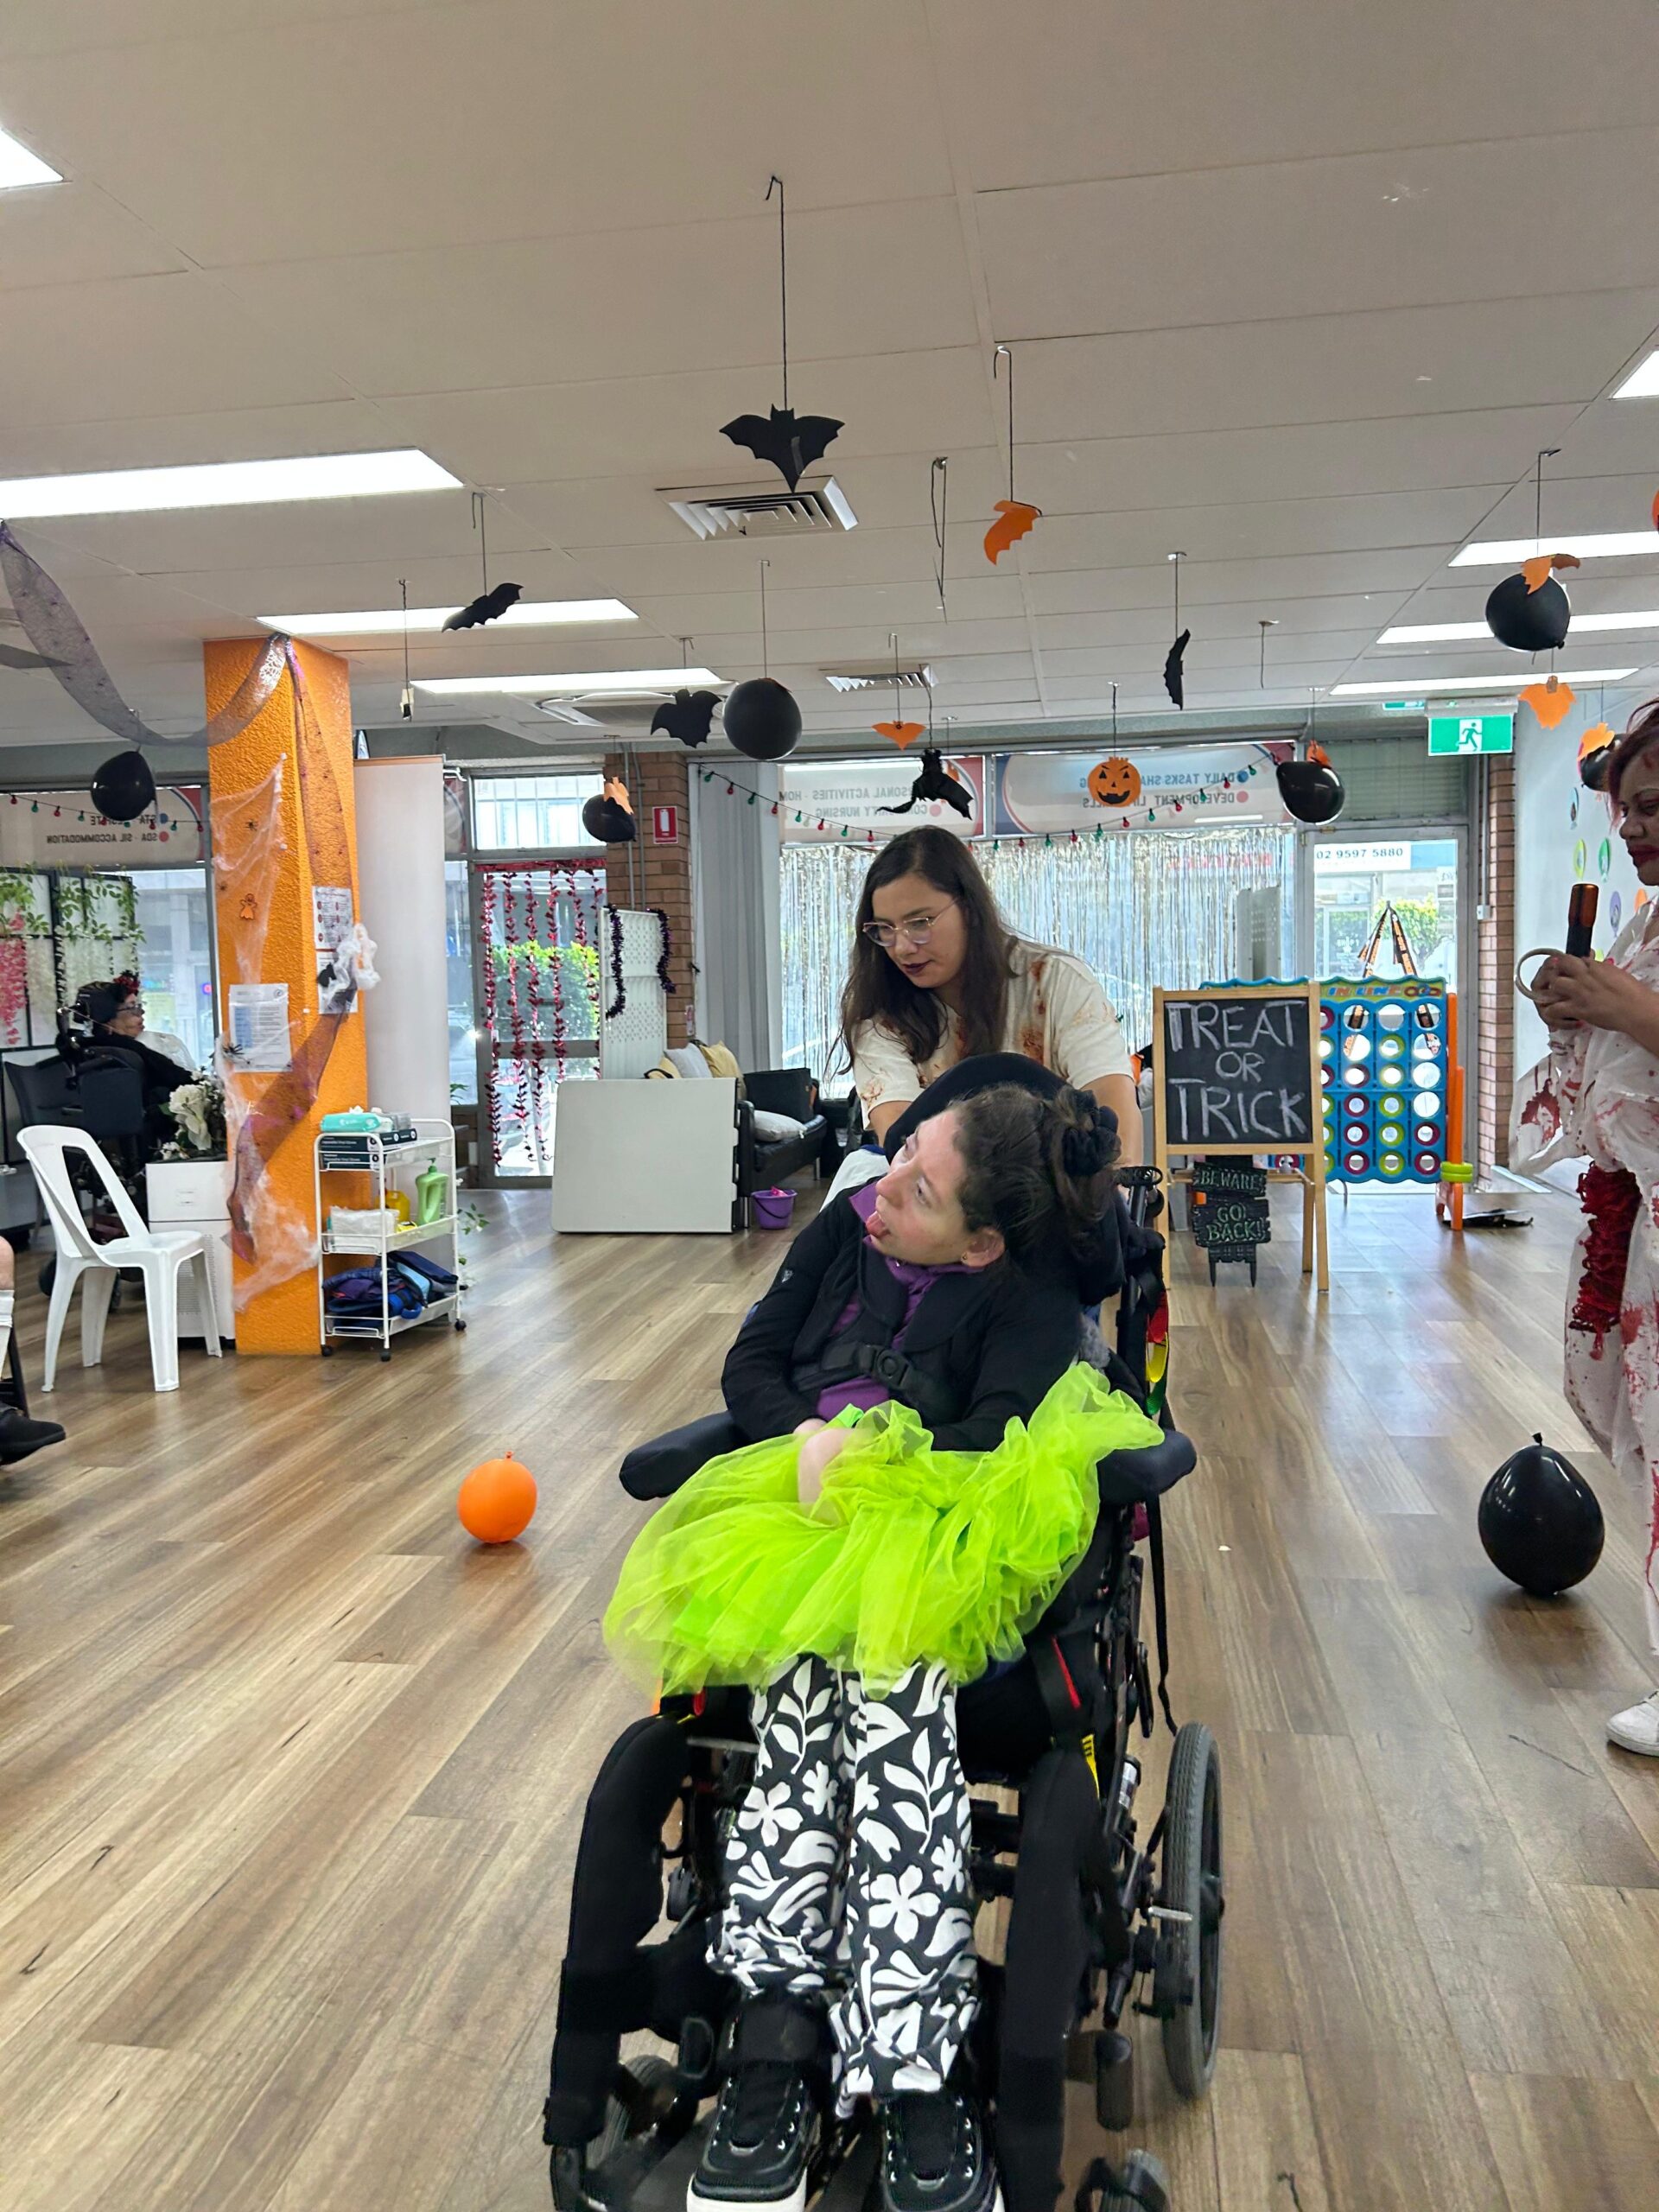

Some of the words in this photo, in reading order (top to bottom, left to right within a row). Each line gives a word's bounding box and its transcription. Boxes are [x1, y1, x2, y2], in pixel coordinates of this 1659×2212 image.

[1316, 850, 1332, 860] 02
[1336, 849, 1367, 859] 9597
[1372, 848, 1403, 858] 5880
[1164, 1001, 1306, 1052] TREAT
[1215, 1051, 1265, 1083] OR
[1168, 1077, 1306, 1141] TRICK
[1205, 1220, 1263, 1241] BACK!
